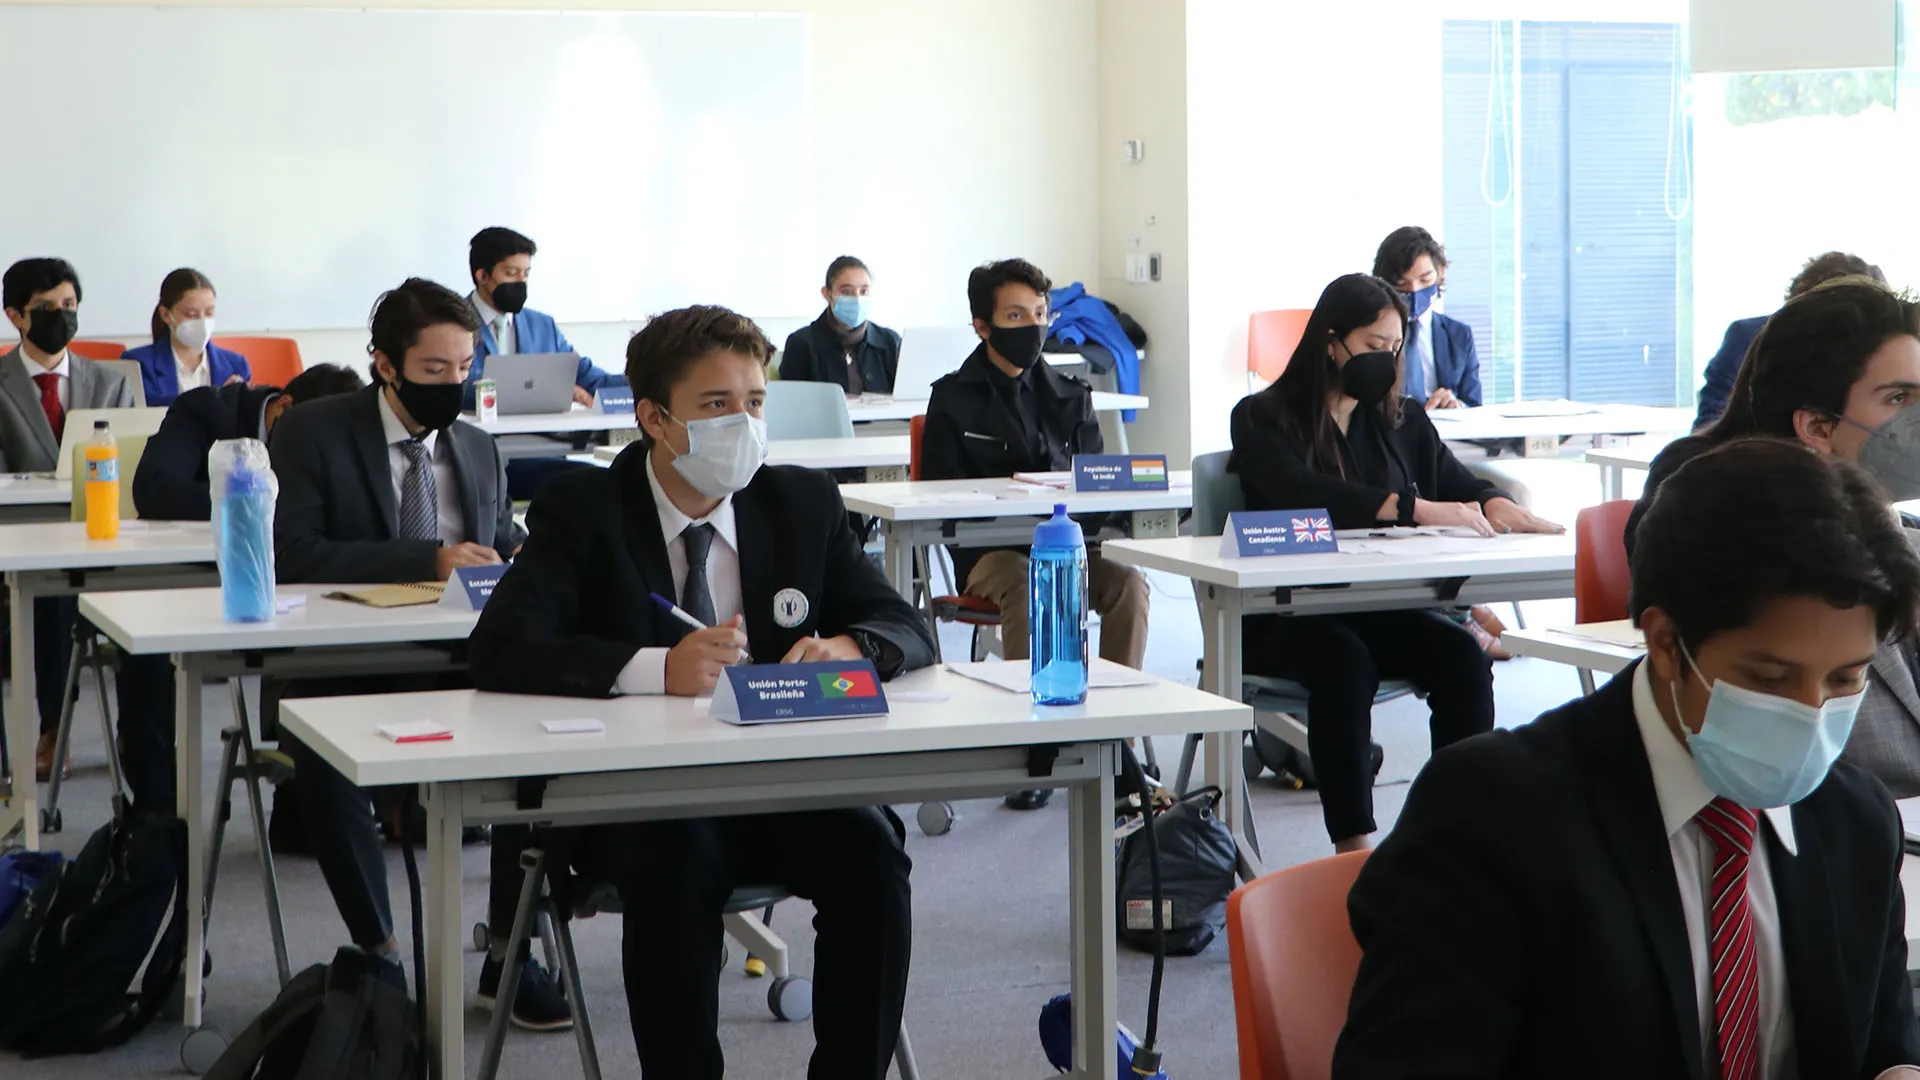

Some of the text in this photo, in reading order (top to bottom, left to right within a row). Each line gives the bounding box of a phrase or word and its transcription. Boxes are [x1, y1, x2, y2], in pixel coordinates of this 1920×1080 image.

[1242, 527, 1262, 535] Unión
[1248, 536, 1286, 544] Canadiense
[748, 679, 808, 689] Unión Porto-
[760, 689, 805, 700] Brasileña
